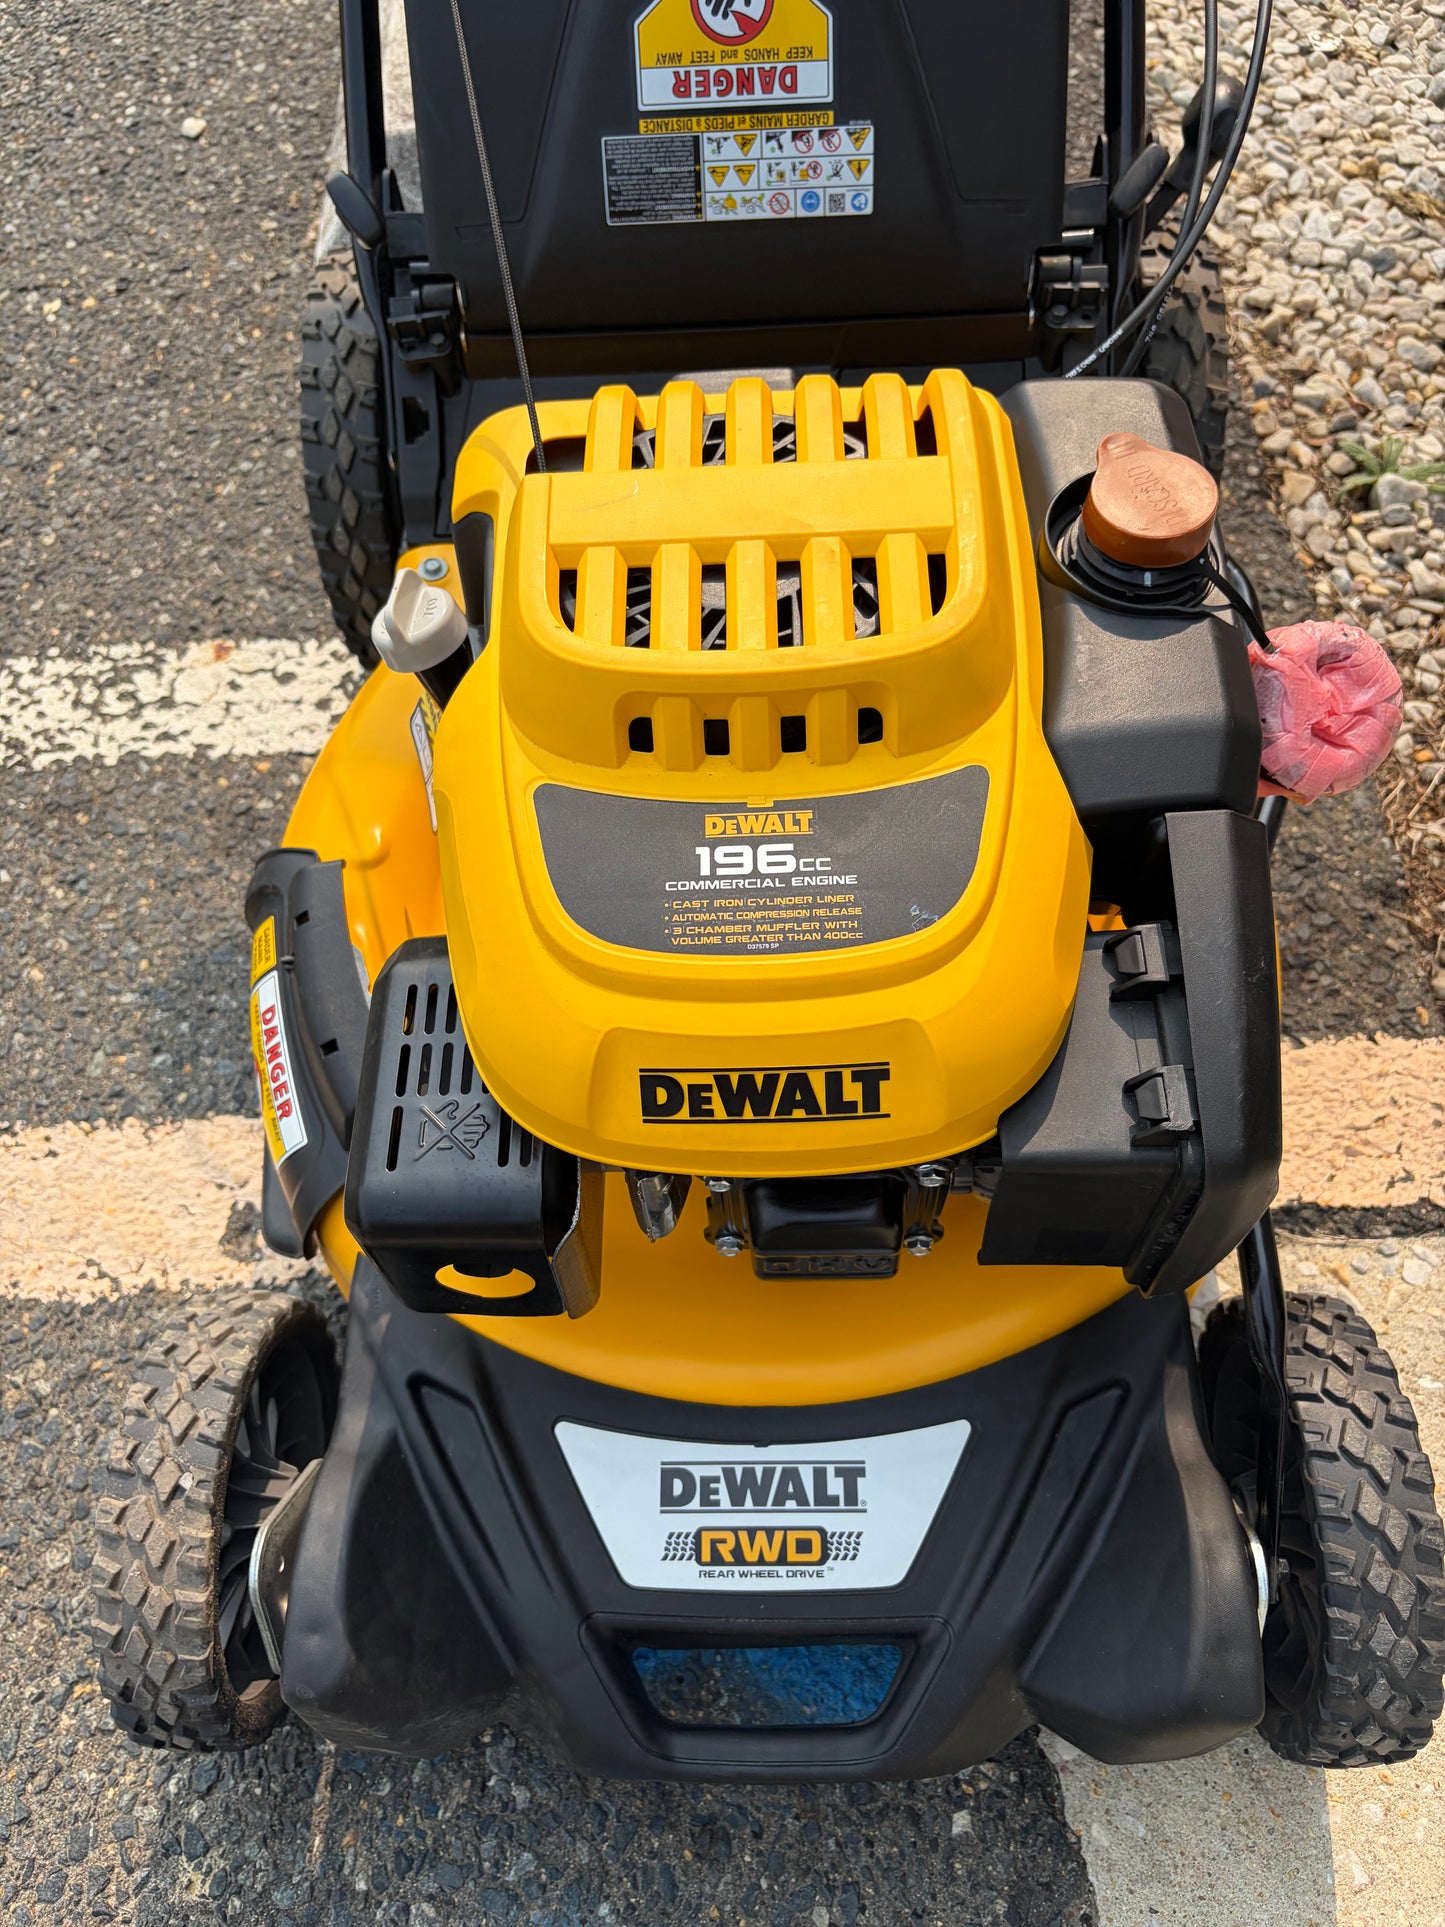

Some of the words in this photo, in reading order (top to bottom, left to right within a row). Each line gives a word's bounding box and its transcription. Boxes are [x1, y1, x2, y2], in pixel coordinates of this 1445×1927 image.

[655, 52, 683, 66] AWAY
[690, 50, 715, 64] FEET
[720, 48, 739, 62] and
[744, 47, 780, 62] HANDS
[786, 46, 813, 60] KEEP
[672, 65, 798, 99] DANGER
[643, 117, 693, 132] DISTANCE
[704, 116, 735, 130] PIEDS
[737, 117, 746, 129] et
[750, 114, 783, 128] MAINS
[786, 112, 829, 126] GARDER
[665, 878, 786, 891] COMMERCIAL
[791, 875, 858, 888] ENGINE
[672, 900, 709, 909] CAST
[713, 898, 744, 908] IRON
[747, 896, 813, 906] CYLINDER
[816, 894, 855, 904] LINER
[672, 912, 734, 922] AUTOMATIC
[736, 909, 810, 920] COMPRESSION
[812, 907, 863, 917] RELEASE
[672, 927, 683, 935] 3
[685, 924, 752, 935] CHAMBER
[755, 922, 821, 932] MUFFLER
[824, 920, 858, 929] WITH
[671, 936, 721, 945] VOLUME
[725, 934, 784, 943] GREATER
[786, 932, 820, 941] THAN
[261, 1003, 293, 1122] DANGER
[700, 1530, 822, 1563] RWD
[698, 1569, 736, 1579] REAR
[738, 1569, 784, 1579] WHEEL
[785, 1569, 825, 1579] DRIVE
